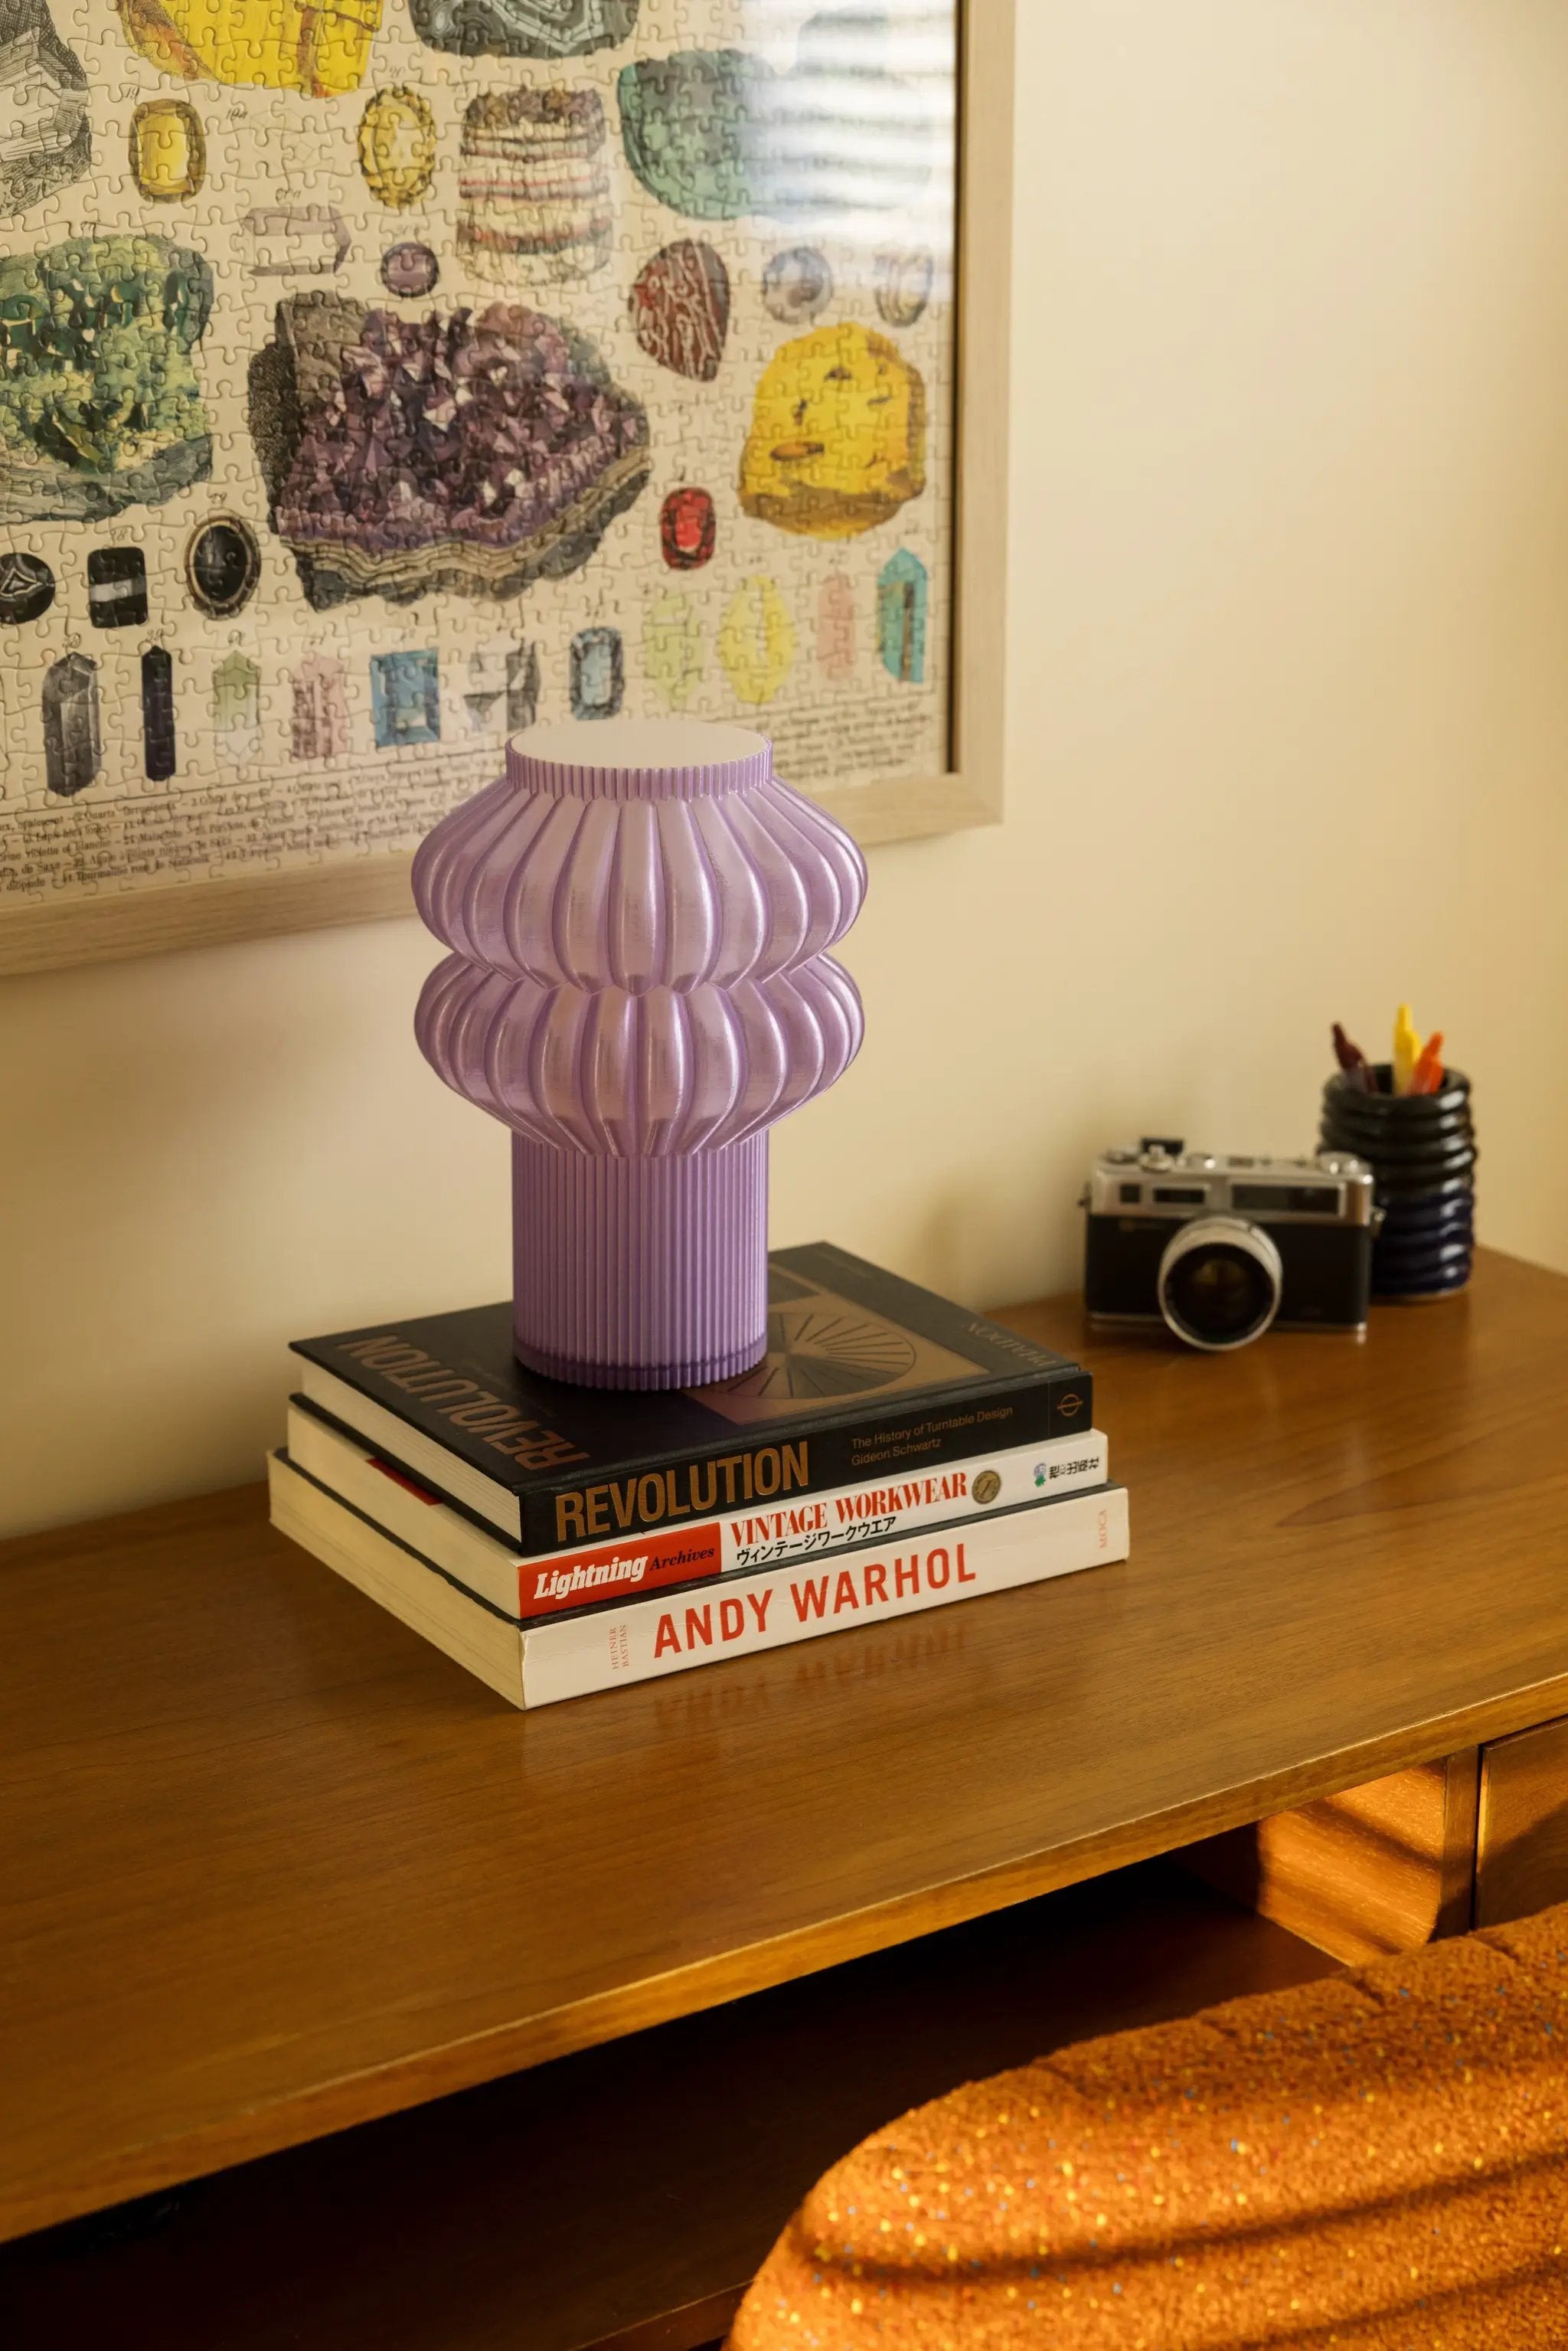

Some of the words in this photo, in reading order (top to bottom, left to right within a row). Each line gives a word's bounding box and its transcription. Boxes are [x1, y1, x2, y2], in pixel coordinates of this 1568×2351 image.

[338, 1335, 590, 1470] REVOLUTION
[851, 1437, 871, 1450] The
[874, 1427, 911, 1445] History
[913, 1423, 926, 1437] of
[926, 1414, 974, 1434] Turntable
[977, 1406, 1013, 1423] Design
[851, 1450, 890, 1466] Gideon
[893, 1437, 942, 1457] Schwartz
[556, 1441, 808, 1542] REVOLUTION
[730, 1502, 828, 1548] VINTAGE
[835, 1472, 967, 1524] WORKWEAR
[534, 1556, 648, 1600] Lightning
[649, 1547, 714, 1571] Archives
[654, 1589, 773, 1659] ANDY
[790, 1543, 976, 1623] WARHOL
[609, 1627, 619, 1669] HEINER
[619, 1624, 629, 1667] BASTIAN
